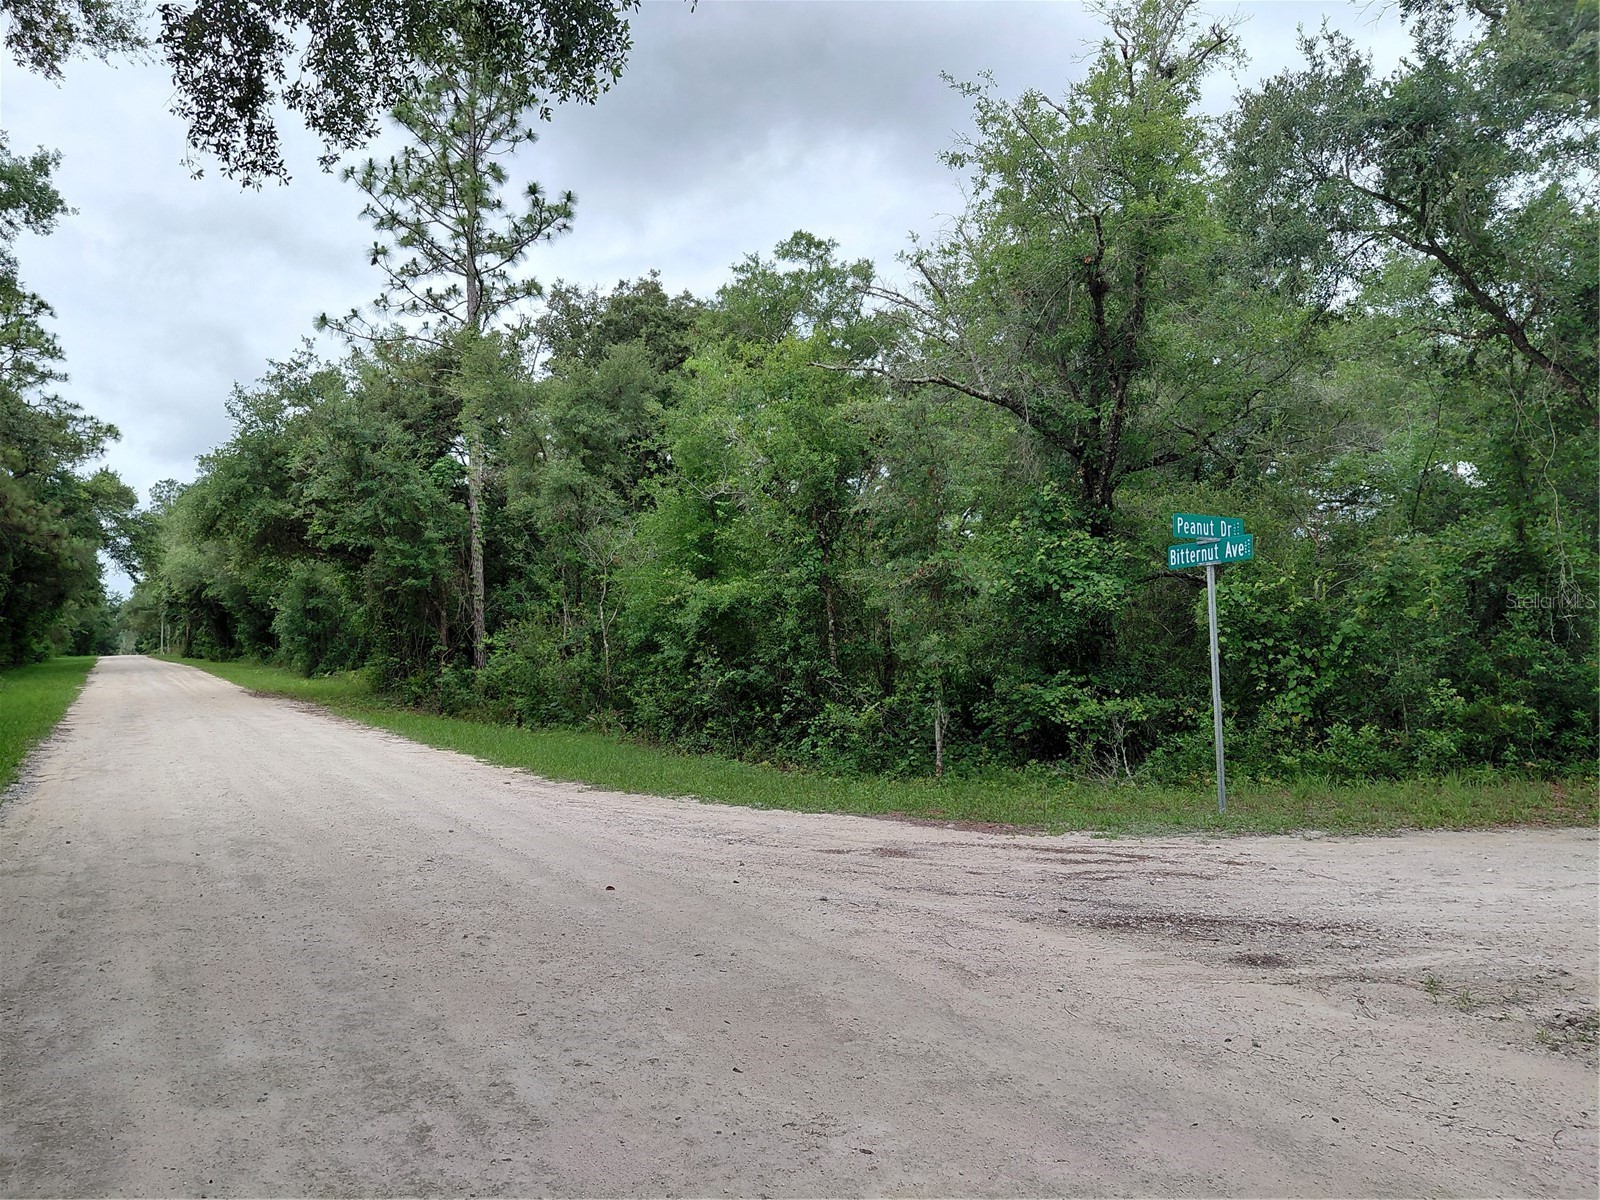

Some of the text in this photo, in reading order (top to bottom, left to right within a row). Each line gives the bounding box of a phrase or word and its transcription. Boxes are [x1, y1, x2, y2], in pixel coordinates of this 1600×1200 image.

[1177, 516, 1215, 536] Peanut
[1220, 520, 1232, 537] Dr
[1170, 543, 1219, 566] Bitternut
[1225, 541, 1244, 558] Ave
